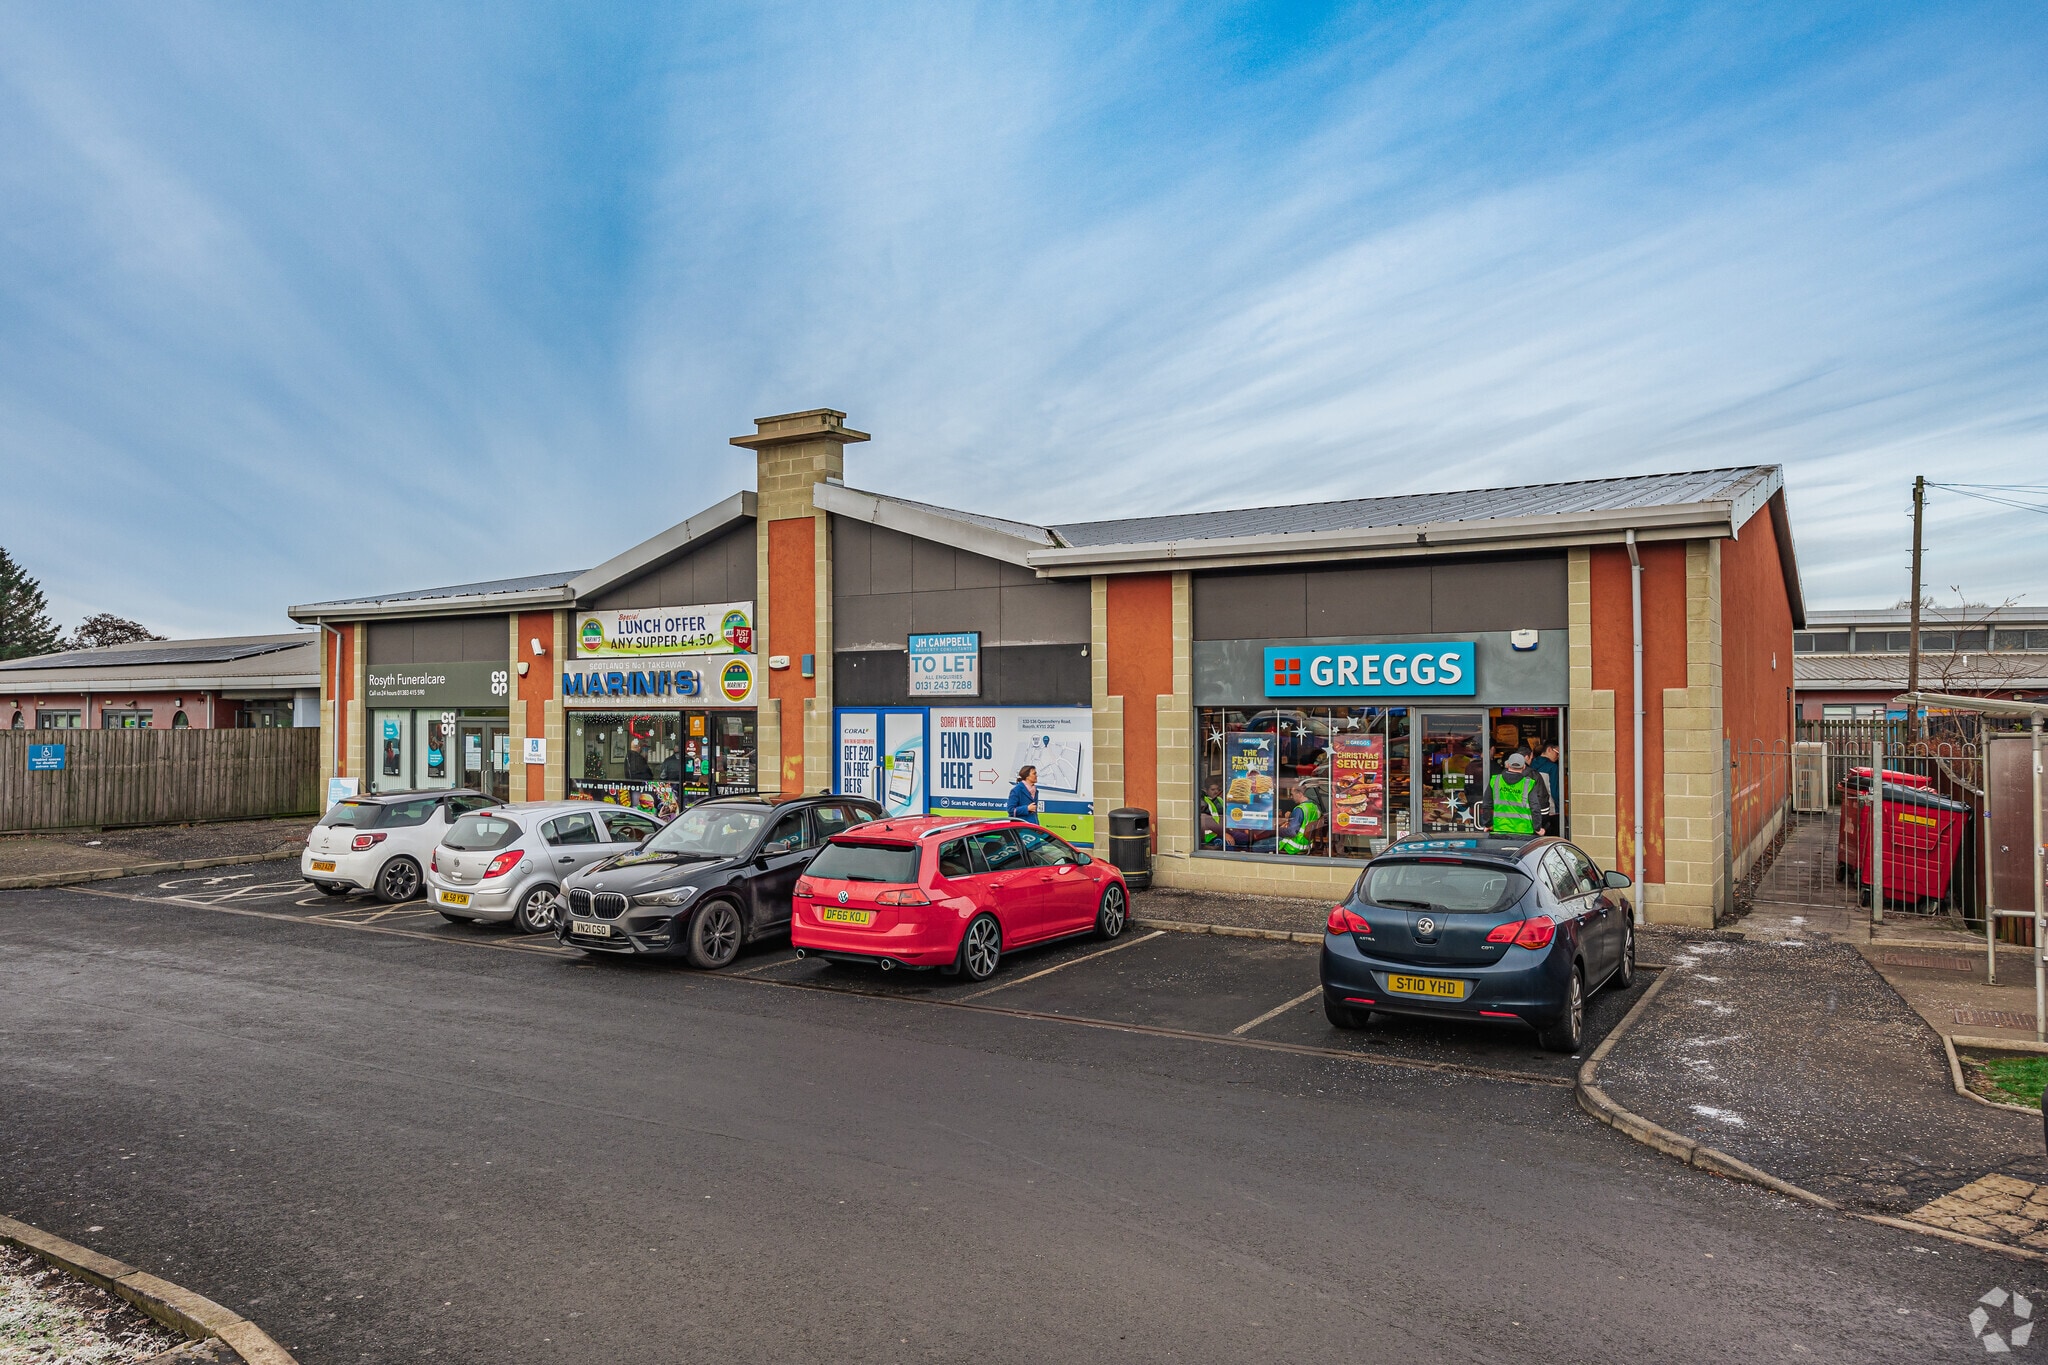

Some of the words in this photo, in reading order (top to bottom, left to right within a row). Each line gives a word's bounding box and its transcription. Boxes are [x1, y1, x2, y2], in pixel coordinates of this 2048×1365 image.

[618, 618, 661, 635] LUNCH
[664, 616, 706, 633] OFFER
[736, 629, 749, 637] JUST
[610, 637, 634, 650] ANY
[635, 634, 678, 649] SUPPER
[681, 633, 714, 647] £4.50
[916, 638, 926, 647] JH
[929, 636, 971, 647] CAMPBELL
[589, 662, 630, 670] SCOTLAND'S
[648, 661, 687, 669] TAKEAWAY
[911, 655, 937, 673] TO
[943, 655, 977, 673] LET
[1310, 652, 1463, 687] GREGGS
[369, 674, 395, 689] Rosyth
[397, 672, 446, 686] Funeralcare
[563, 670, 698, 697] MARINI'S
[727, 681, 747, 689] MARINI'S
[915, 681, 931, 690] 0131
[934, 681, 949, 690] 243
[952, 680, 972, 690] 7288
[940, 716, 958, 728] SORRY
[958, 717, 975, 728] WE'RE
[976, 717, 996, 728] CLOSED
[844, 745, 858, 761] GET
[859, 746, 874, 761] £20
[940, 732, 970, 759] FIND
[974, 732, 993, 760] US
[1243, 749, 1258, 757] THE
[1231, 756, 1268, 765] FESTIVE
[1337, 752, 1379, 760] CHRISTMAS
[844, 762, 852, 777] IN
[853, 762, 870, 777] FREE
[1336, 760, 1379, 770] SERVED
[940, 762, 973, 790] HERE
[844, 778, 862, 794] BETS
[826, 909, 849, 920] DF66
[850, 911, 866, 922] KOJ
[1396, 977, 1425, 992] ST10
[1429, 980, 1456, 995] YHD
